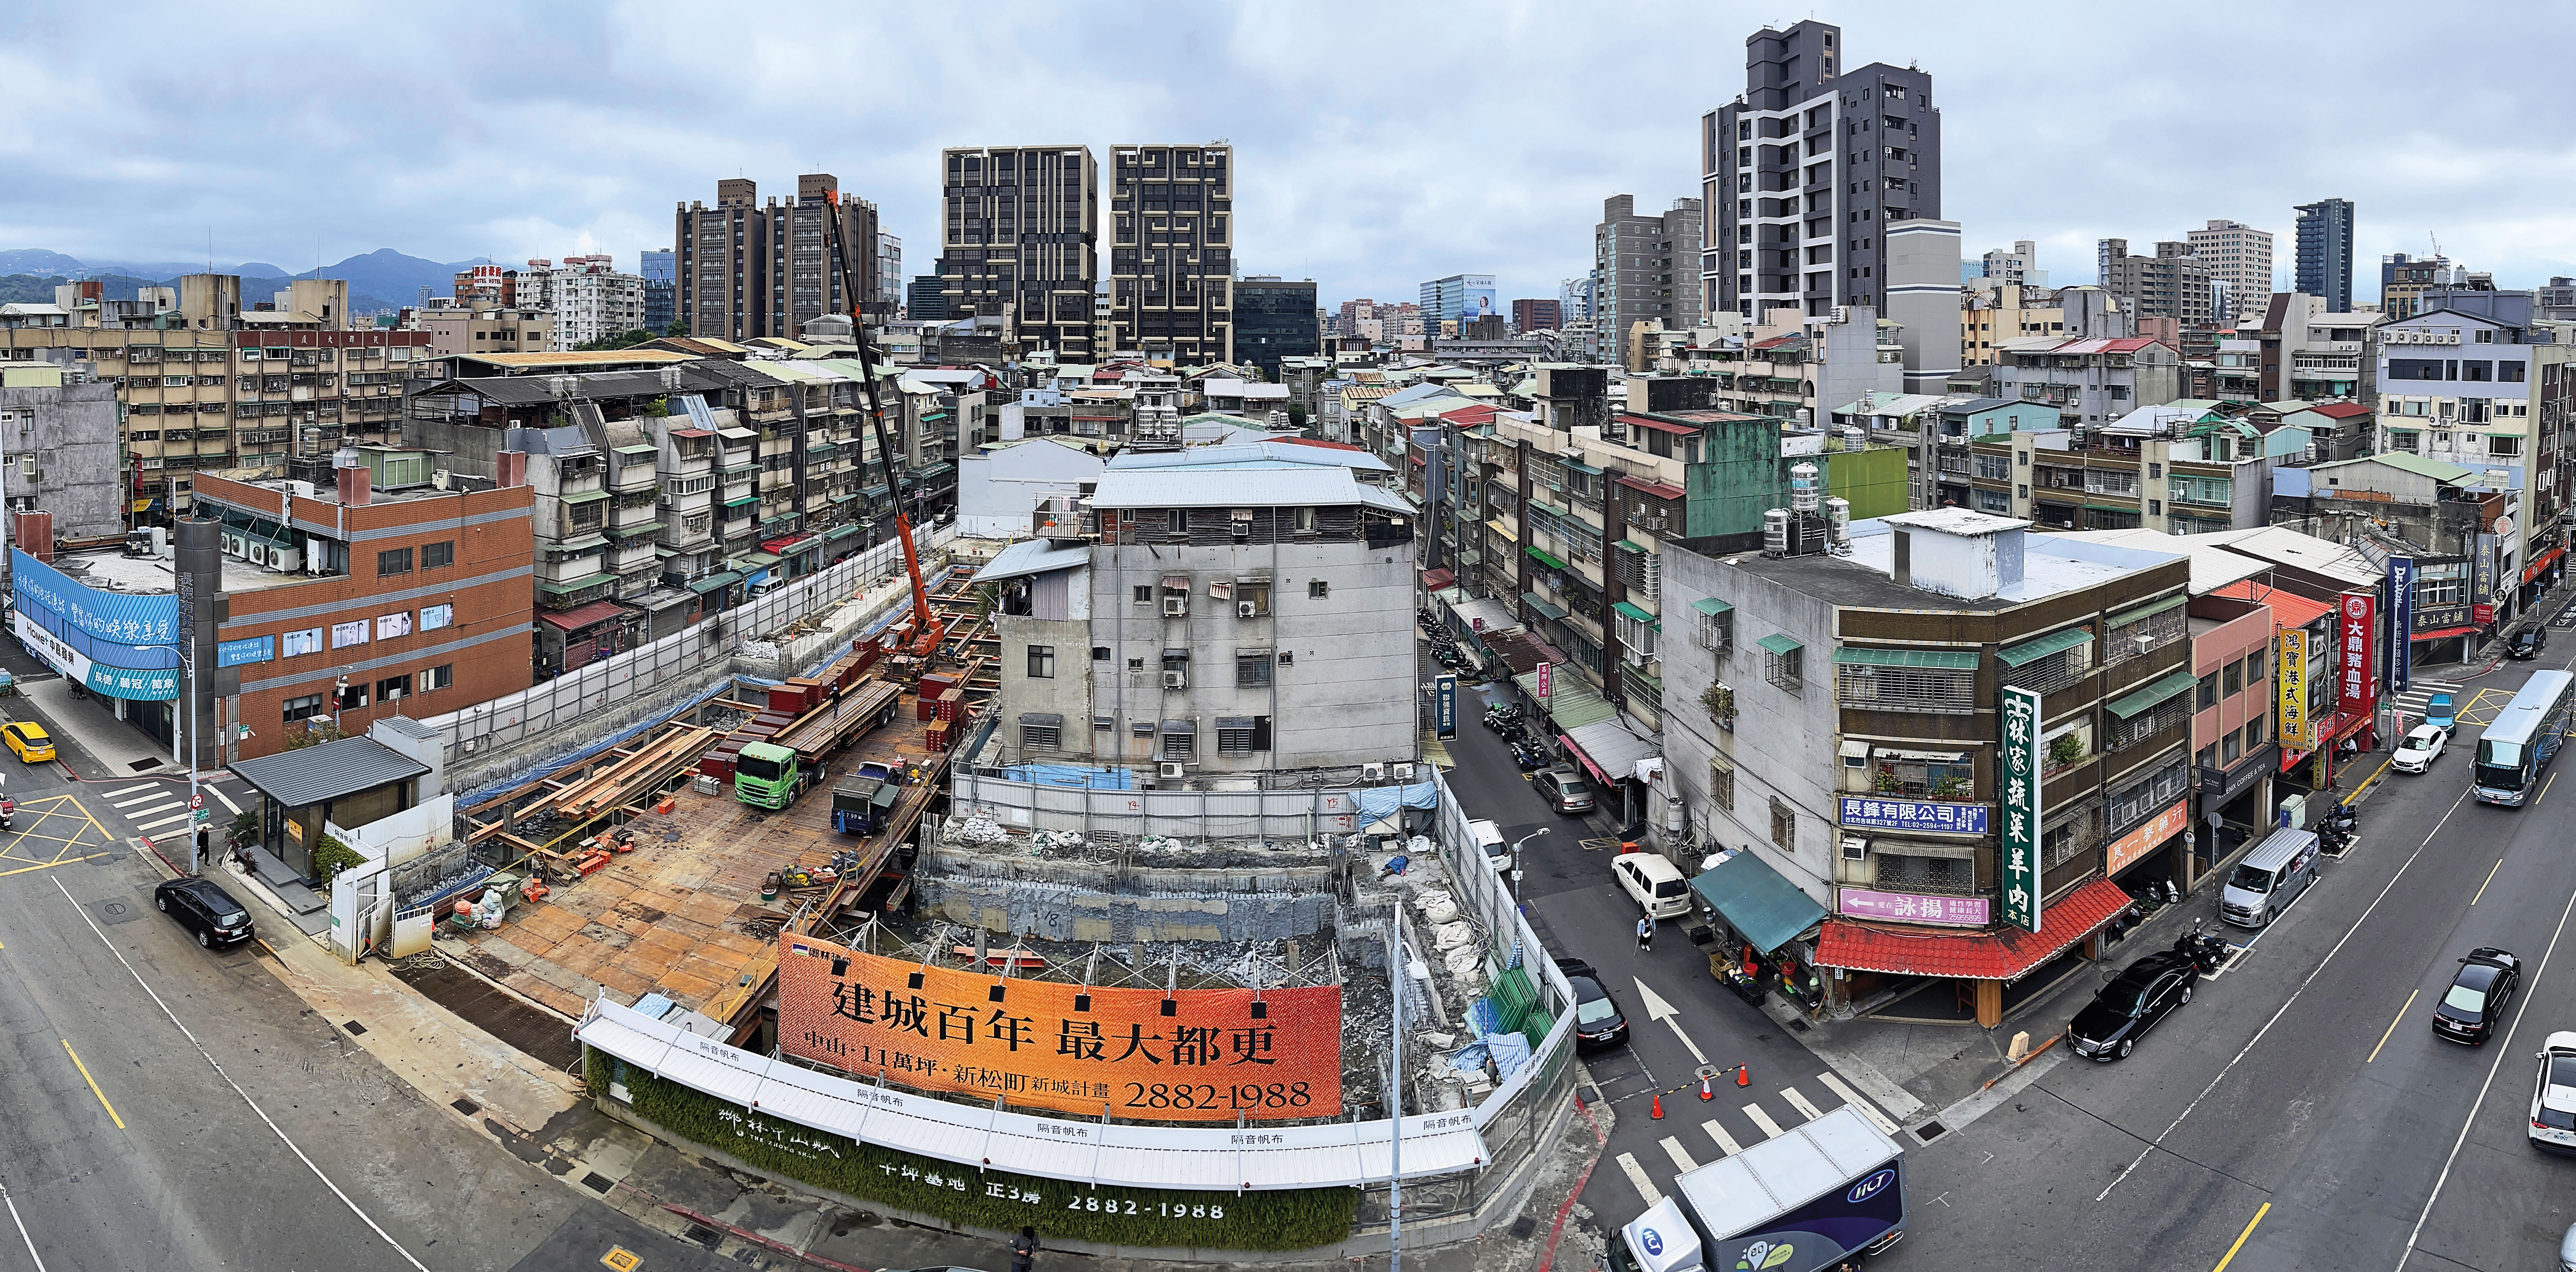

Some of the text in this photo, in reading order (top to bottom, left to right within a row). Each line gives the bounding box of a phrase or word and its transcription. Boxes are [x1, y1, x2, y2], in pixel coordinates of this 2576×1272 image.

[2498, 519, 2509, 533] 當
[2477, 544, 2491, 595] 泰山當舖
[2497, 591, 2504, 600] 當
[2417, 611, 2463, 627] 泰山當舖
[50, 639, 74, 666] 中嘉寬頻
[2345, 620, 2363, 699] 大鼎豬血湯
[2284, 634, 2300, 737] 鴻寶港式海鮮
[2280, 738, 2303, 747] 2585-5368
[2217, 783, 2236, 801] PENIX
[2237, 771, 2254, 787] COFFEE
[1327, 798, 1338, 808] Y5
[1845, 800, 1953, 823] 長鋒有限公司
[1845, 816, 1953, 830] 台北市吉林路327號2F TEL:02-2594-1197
[334, 829, 354, 846] 隔音帆布
[1894, 896, 1943, 919] 詠揚
[1949, 914, 1981, 922] 25955895
[2008, 910, 2030, 927] 本店
[830, 980, 1277, 1066] 建城百年 最大都更
[699, 1039, 740, 1062] 隔音帆布
[1524, 1045, 1546, 1076] 隔音帆布
[857, 1088, 904, 1107] 隔音帆布
[1031, 1075, 1110, 1099] 新城計畫
[1124, 1082, 1312, 1110] 2882-1988
[1036, 1123, 1089, 1139] 隔音帆布
[1424, 1114, 1472, 1131] 隔音帆布
[750, 1134, 763, 1142] THE
[768, 1141, 794, 1153] ZHONG
[1231, 1133, 1284, 1146] 隔音帆布
[1855, 1173, 1887, 1199] HCT
[985, 1181, 1041, 1205] 正3房
[1068, 1196, 1224, 1220] 2882-1988
[1643, 1230, 1662, 1250] HCT
[1750, 1245, 1764, 1257] 80
